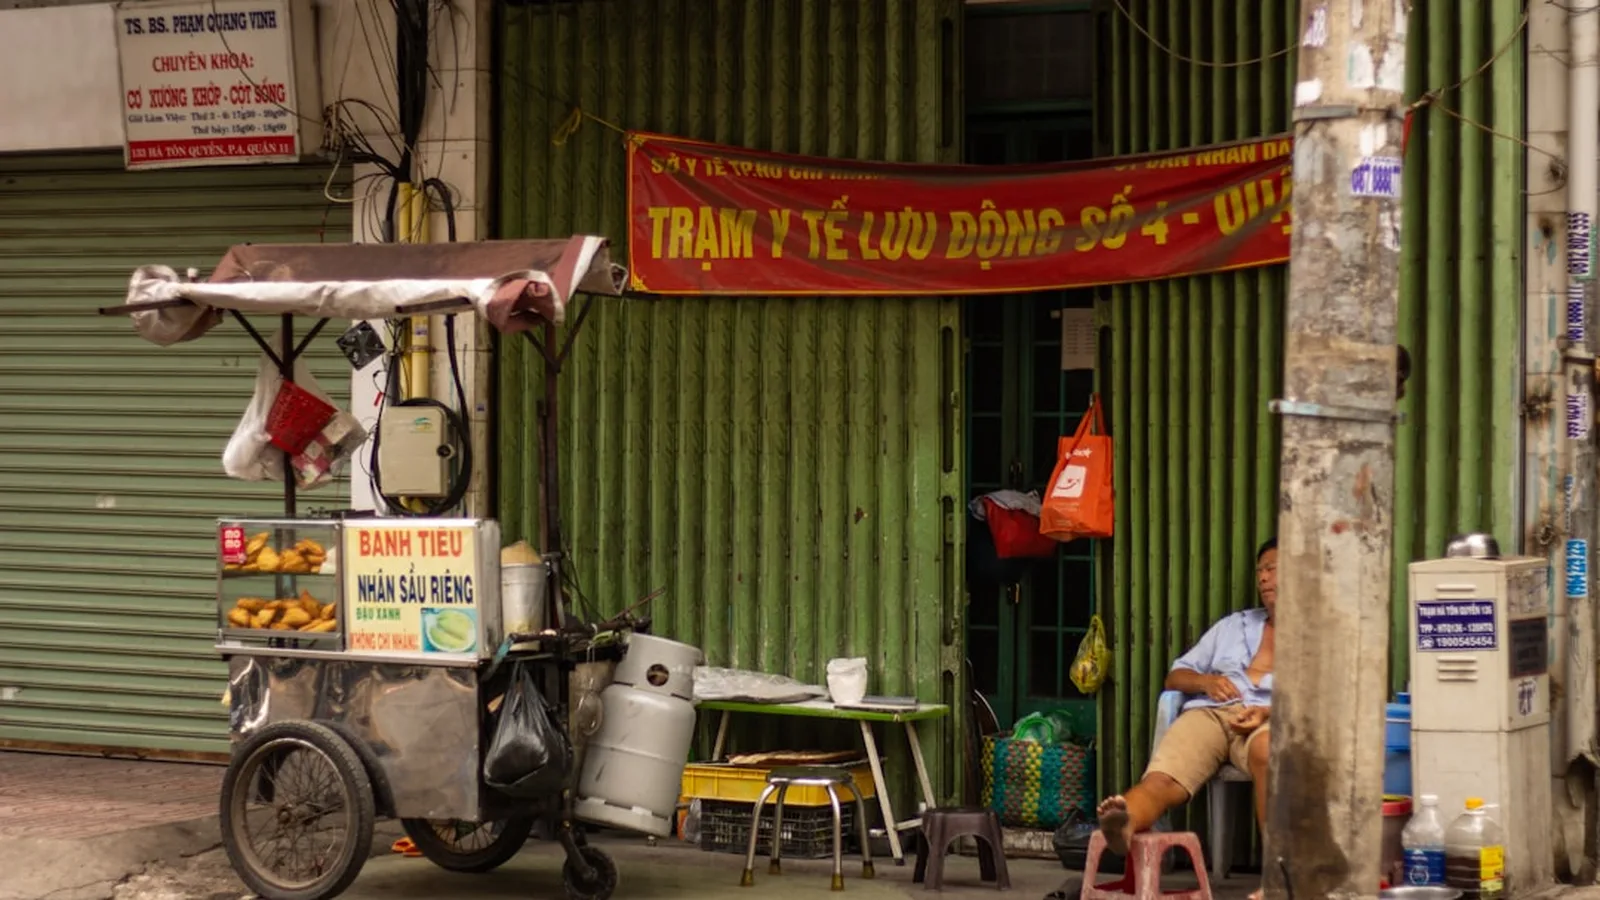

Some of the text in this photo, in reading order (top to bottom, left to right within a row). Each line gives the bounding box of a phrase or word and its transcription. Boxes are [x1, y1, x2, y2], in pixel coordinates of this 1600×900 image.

[125, 18, 144, 34] TS.
[148, 17, 169, 34] BS.
[207, 13, 247, 32] QUANG
[249, 11, 277, 30] VINH
[152, 52, 254, 73] CHUYÊN KHOA:
[279, 144, 288, 153] 11
[685, 158, 697, 177] Y
[648, 206, 757, 271] TRẠM
[768, 208, 790, 259] Y
[802, 194, 849, 260] TẾ
[858, 206, 938, 261] LƯU
[946, 199, 1065, 270] ĐỘNG
[1075, 185, 1135, 252] SỐ
[1141, 201, 1169, 245] 4
[358, 568, 395, 602] NHÂN
[430, 568, 473, 604] RIÊNG
[376, 608, 400, 620] XANH
